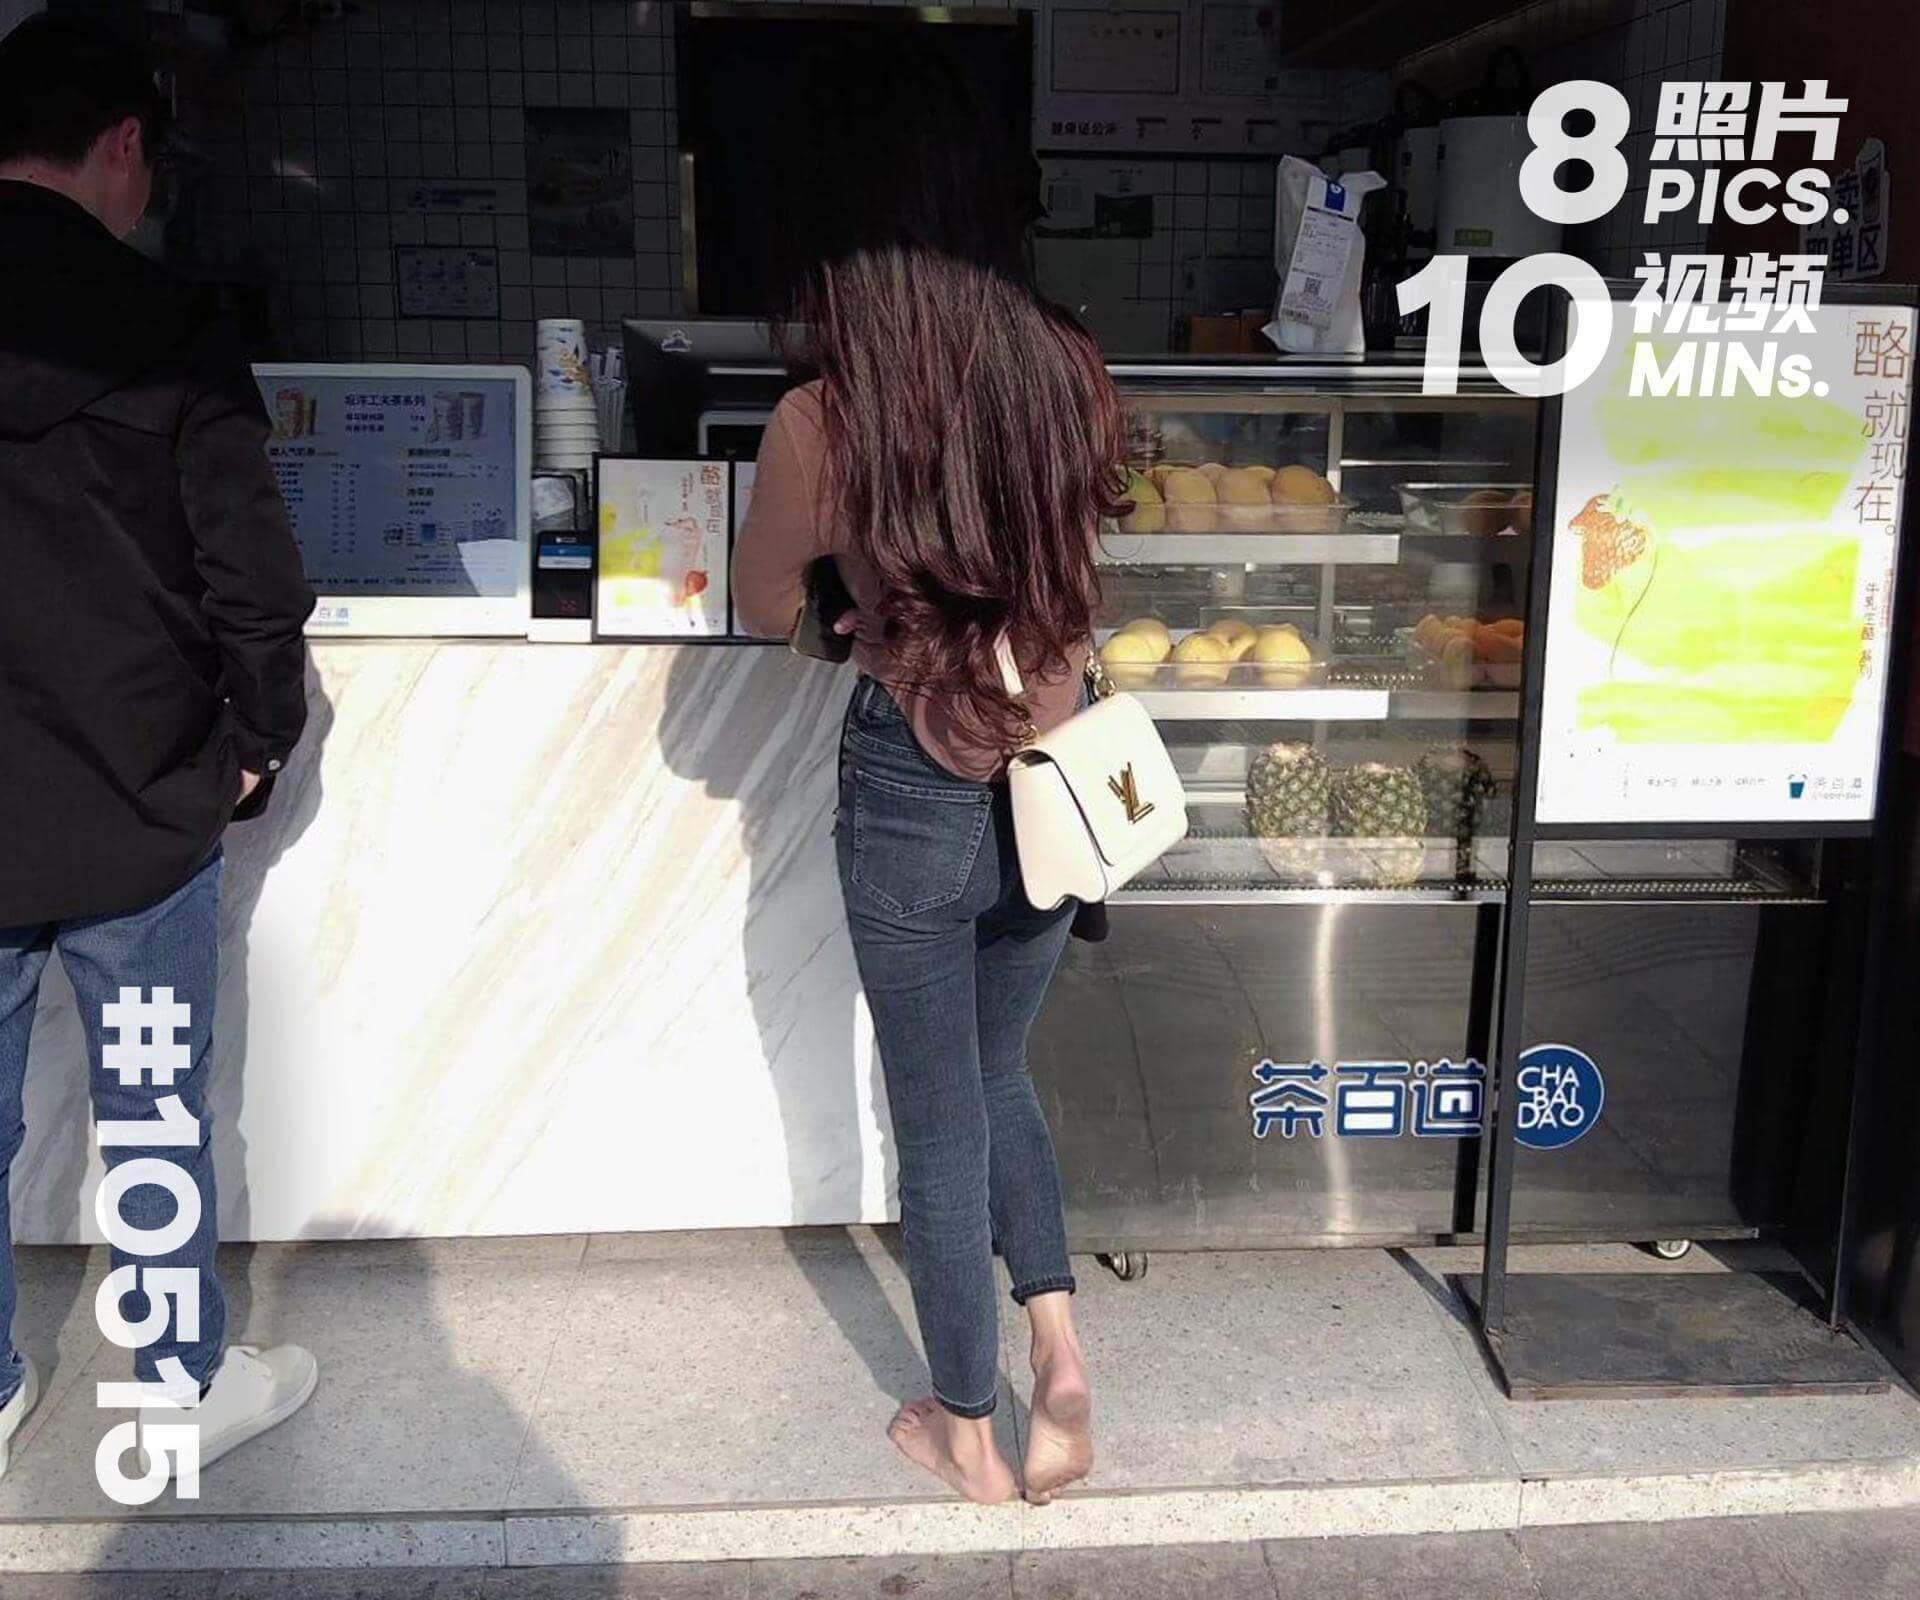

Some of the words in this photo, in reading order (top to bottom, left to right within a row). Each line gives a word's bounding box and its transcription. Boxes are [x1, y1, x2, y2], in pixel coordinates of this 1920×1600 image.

[1516, 1064, 1580, 1092] CHA
[1250, 1058, 1487, 1139] 茶百道
[1533, 1086, 1577, 1110] BAI
[1517, 1102, 1585, 1129] DAO
